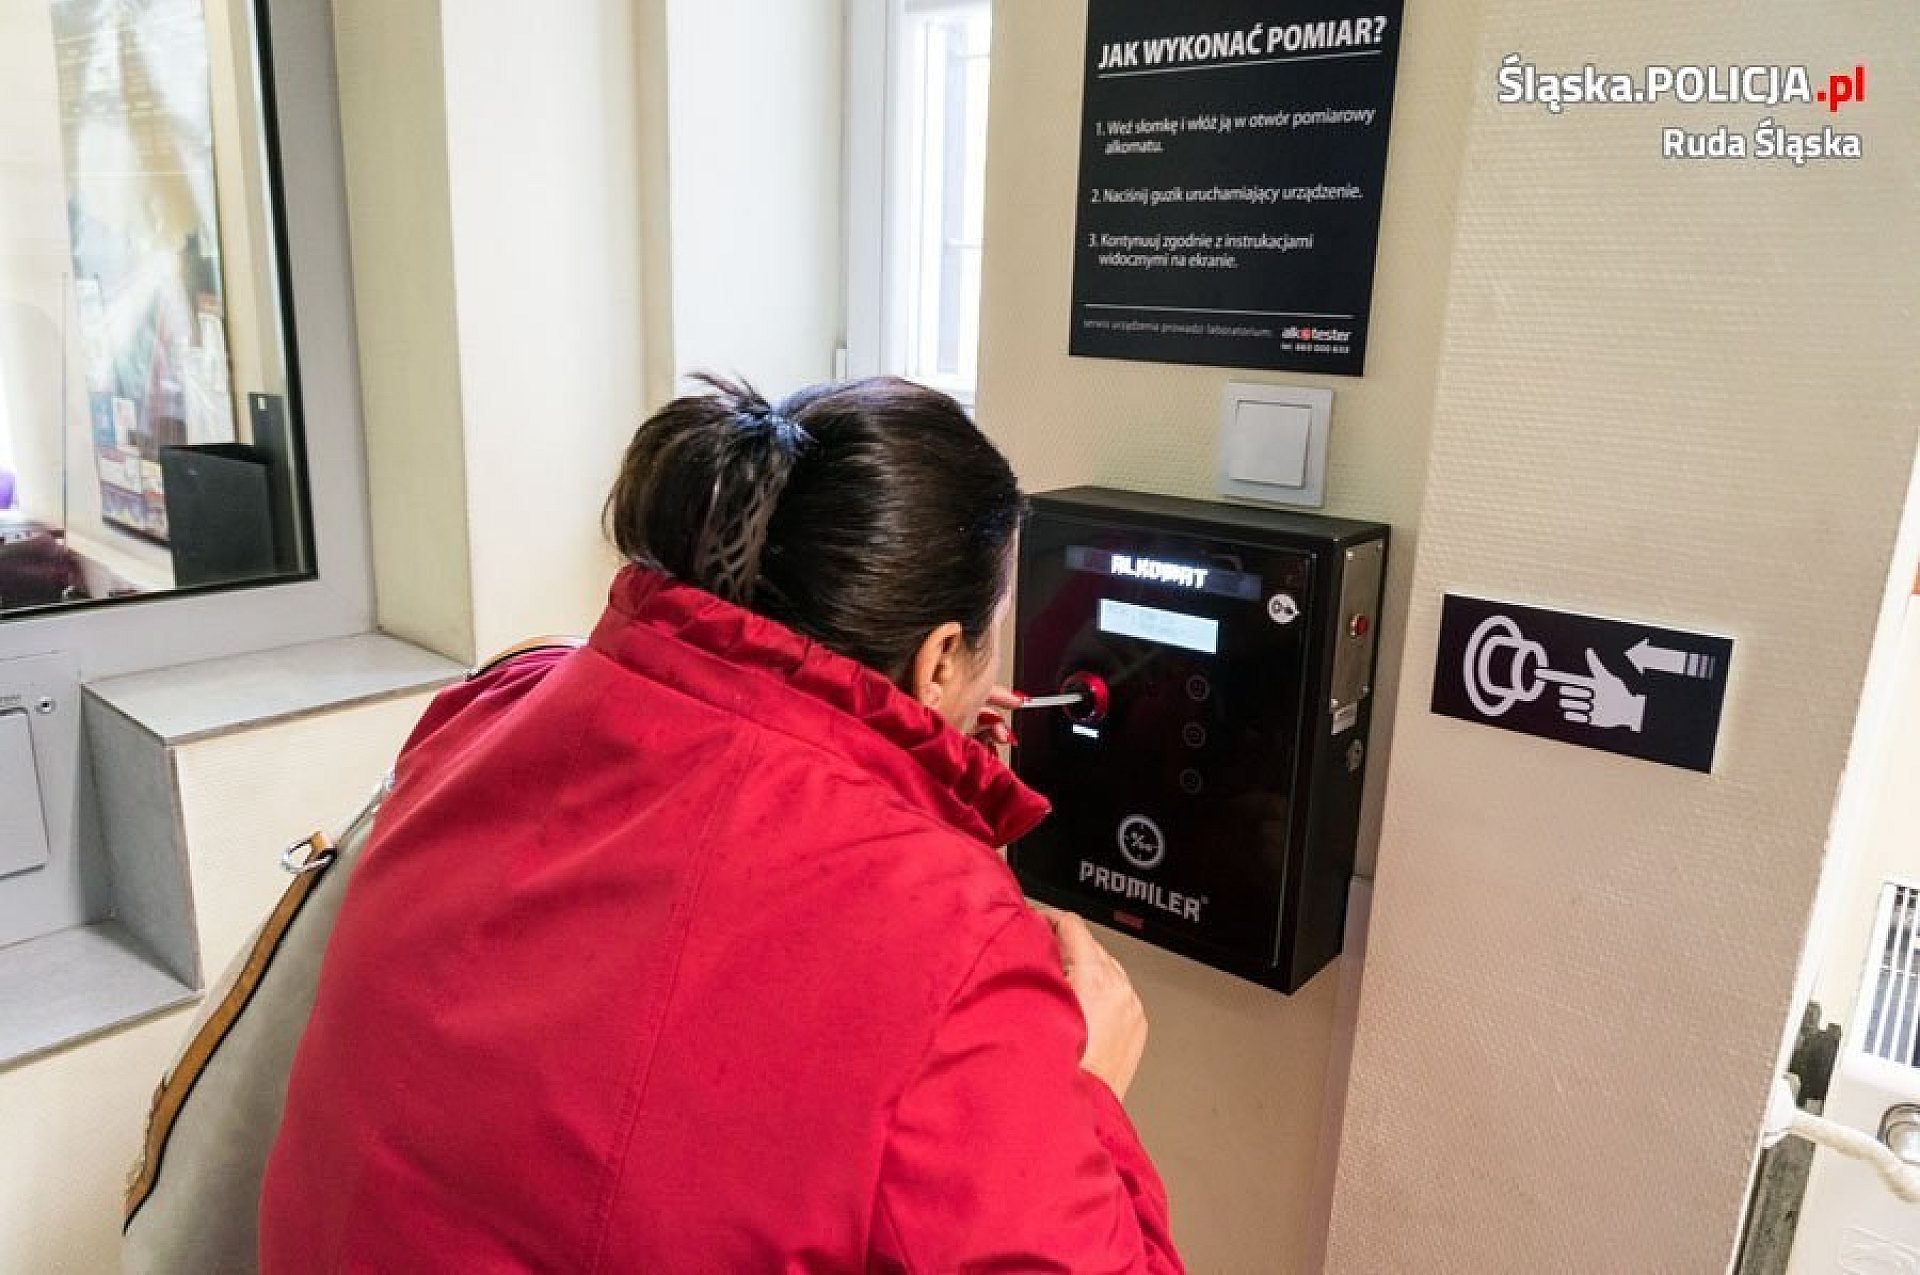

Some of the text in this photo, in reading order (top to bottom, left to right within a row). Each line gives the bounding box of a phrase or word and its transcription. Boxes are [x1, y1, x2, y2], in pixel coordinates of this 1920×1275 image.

[1098, 15, 1388, 69] JAK WYKONAĆ POMIAR?
[1235, 117, 1247, 128] w
[1249, 112, 1289, 128] otwór
[1292, 108, 1376, 129] pomiarowy
[1151, 187, 1182, 206] guzik
[1185, 186, 1280, 205] uruchamiający
[1282, 182, 1364, 203] urządzenie.
[1101, 233, 1161, 254] Kontynuuj
[1162, 232, 1213, 254] zgodnie
[1215, 237, 1222, 248] z
[1098, 253, 1238, 270] widocznymi na ekranie.
